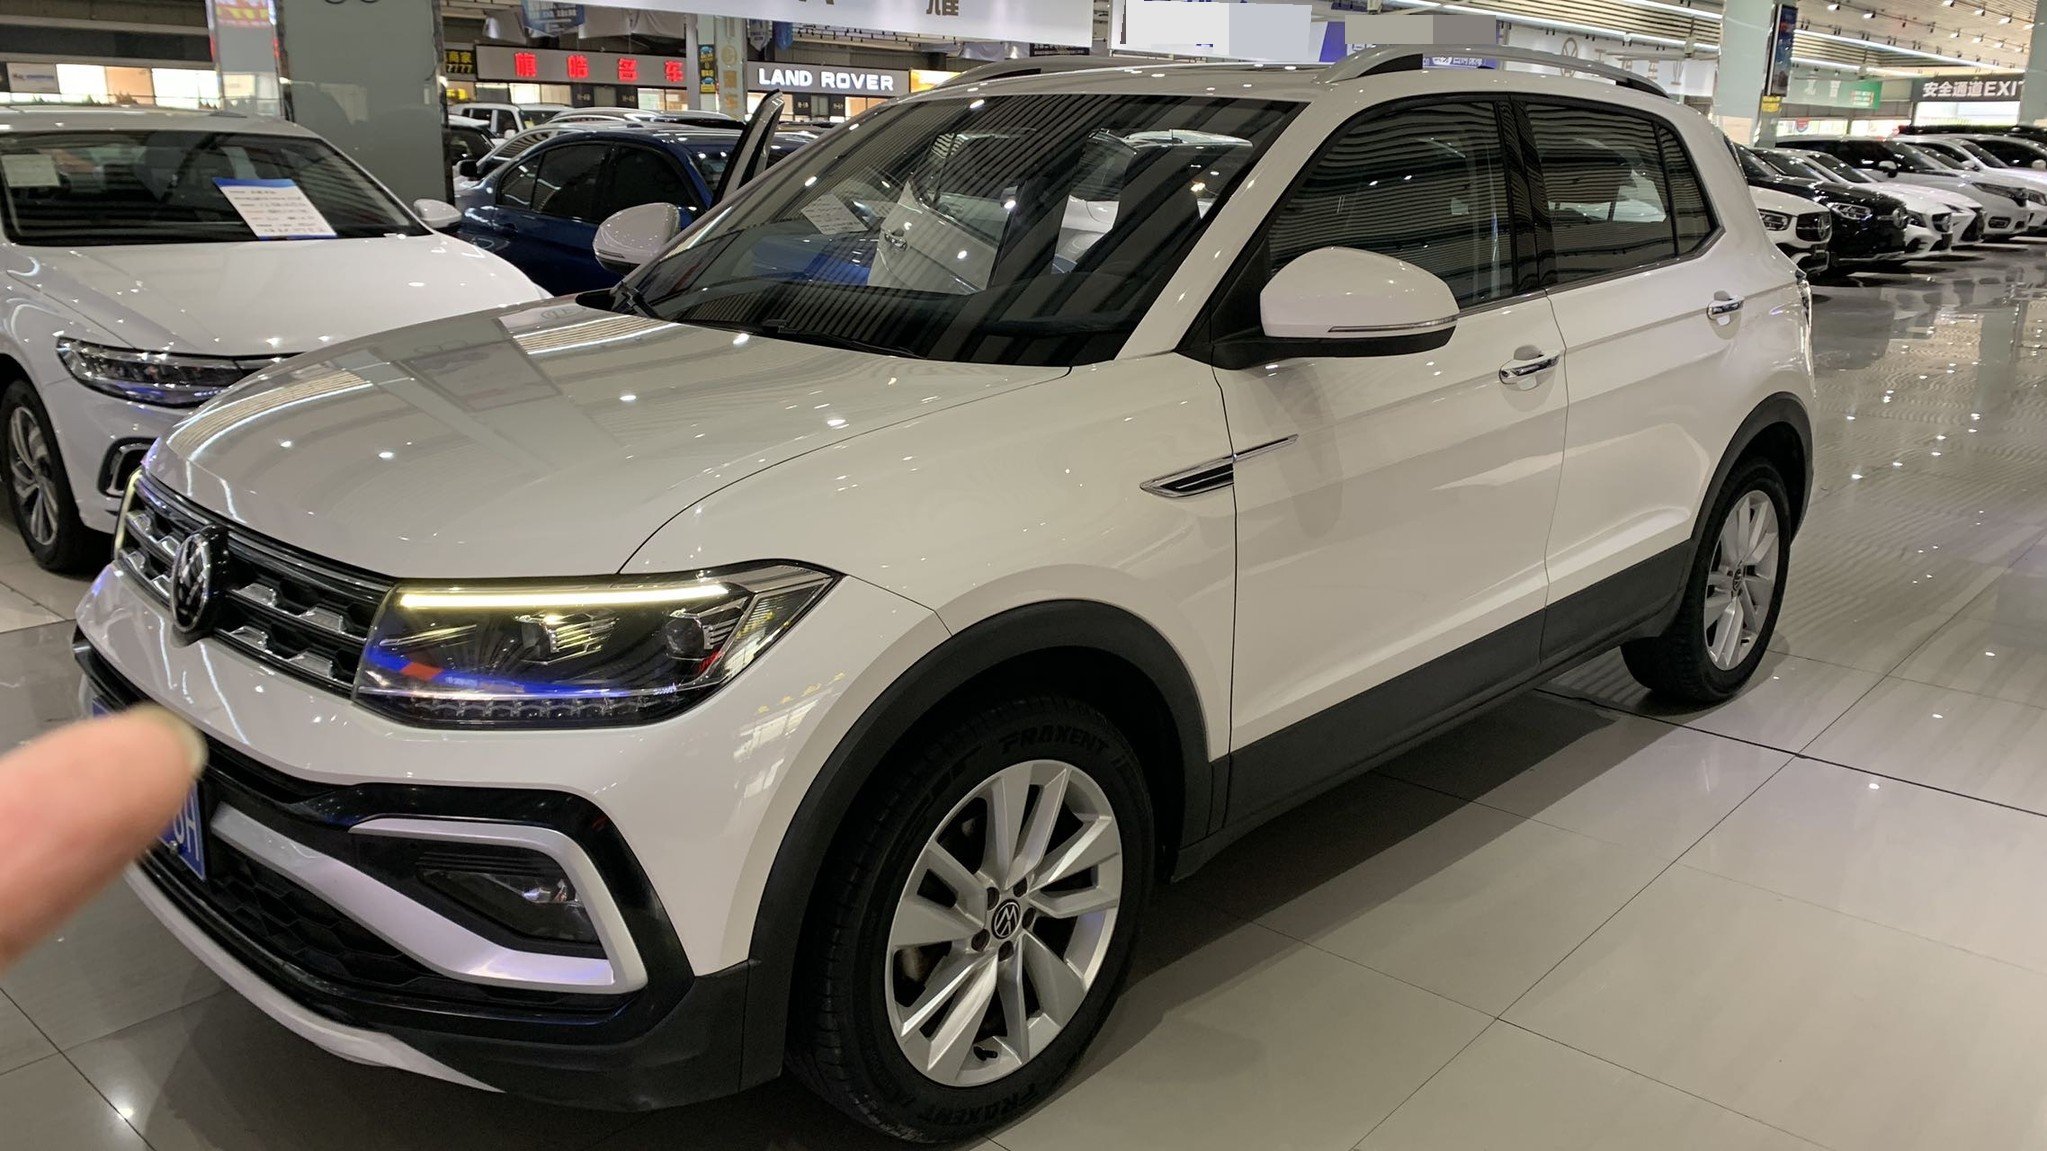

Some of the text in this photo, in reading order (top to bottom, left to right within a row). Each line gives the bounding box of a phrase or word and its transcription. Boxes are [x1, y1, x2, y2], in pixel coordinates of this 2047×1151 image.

[758, 67, 894, 92] LAND ROVER
[1922, 81, 1983, 98] 安全通道
